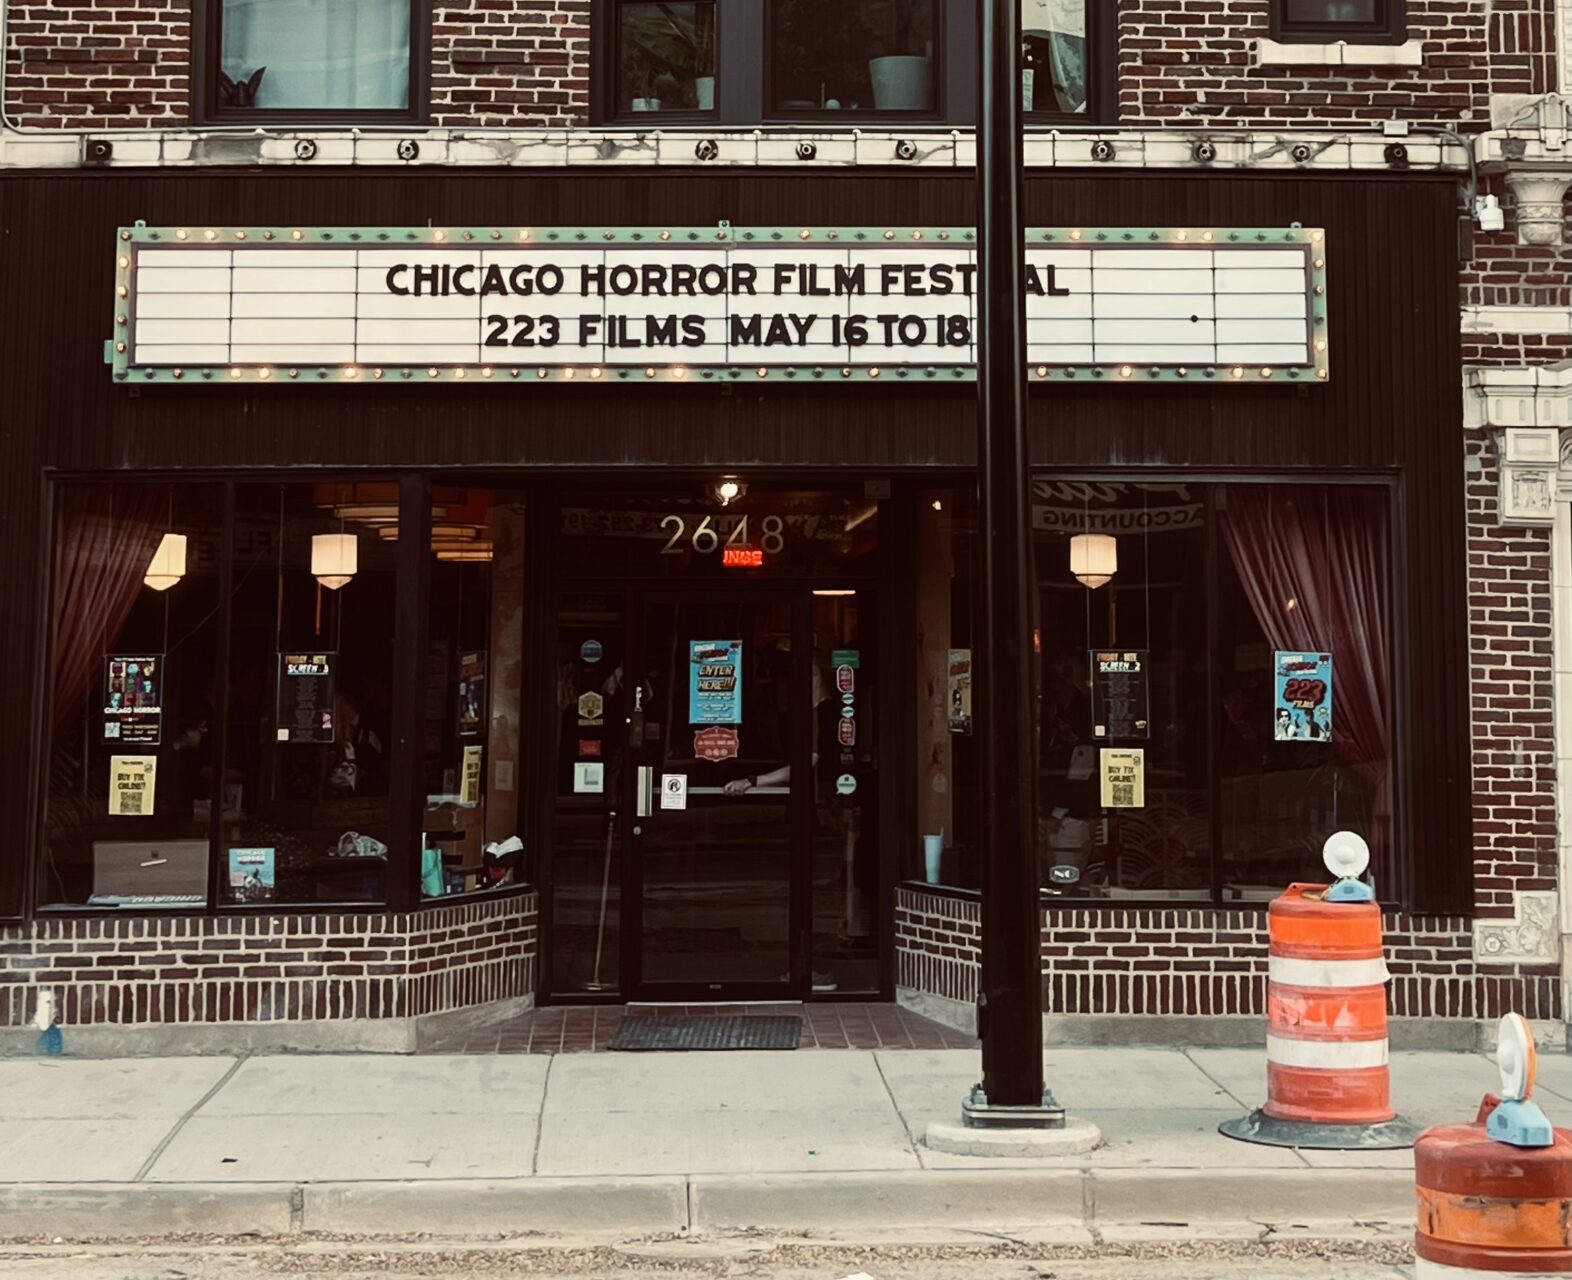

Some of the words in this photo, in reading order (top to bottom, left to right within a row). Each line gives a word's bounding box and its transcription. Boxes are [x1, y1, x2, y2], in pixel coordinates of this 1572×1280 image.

[385, 264, 564, 296] CHICAGO
[580, 264, 757, 296] HORROR
[773, 263, 866, 297] FILM
[880, 263, 1070, 296] FESTAL
[484, 314, 560, 347] 223
[579, 314, 706, 348] FILMS
[730, 313, 817, 347] MAY
[832, 314, 869, 347] 16
[877, 314, 927, 347] TO
[937, 314, 971, 347] 18
[659, 514, 784, 554] 2648
[699, 664, 735, 677] ENTER
[1284, 679, 1326, 702] 223
